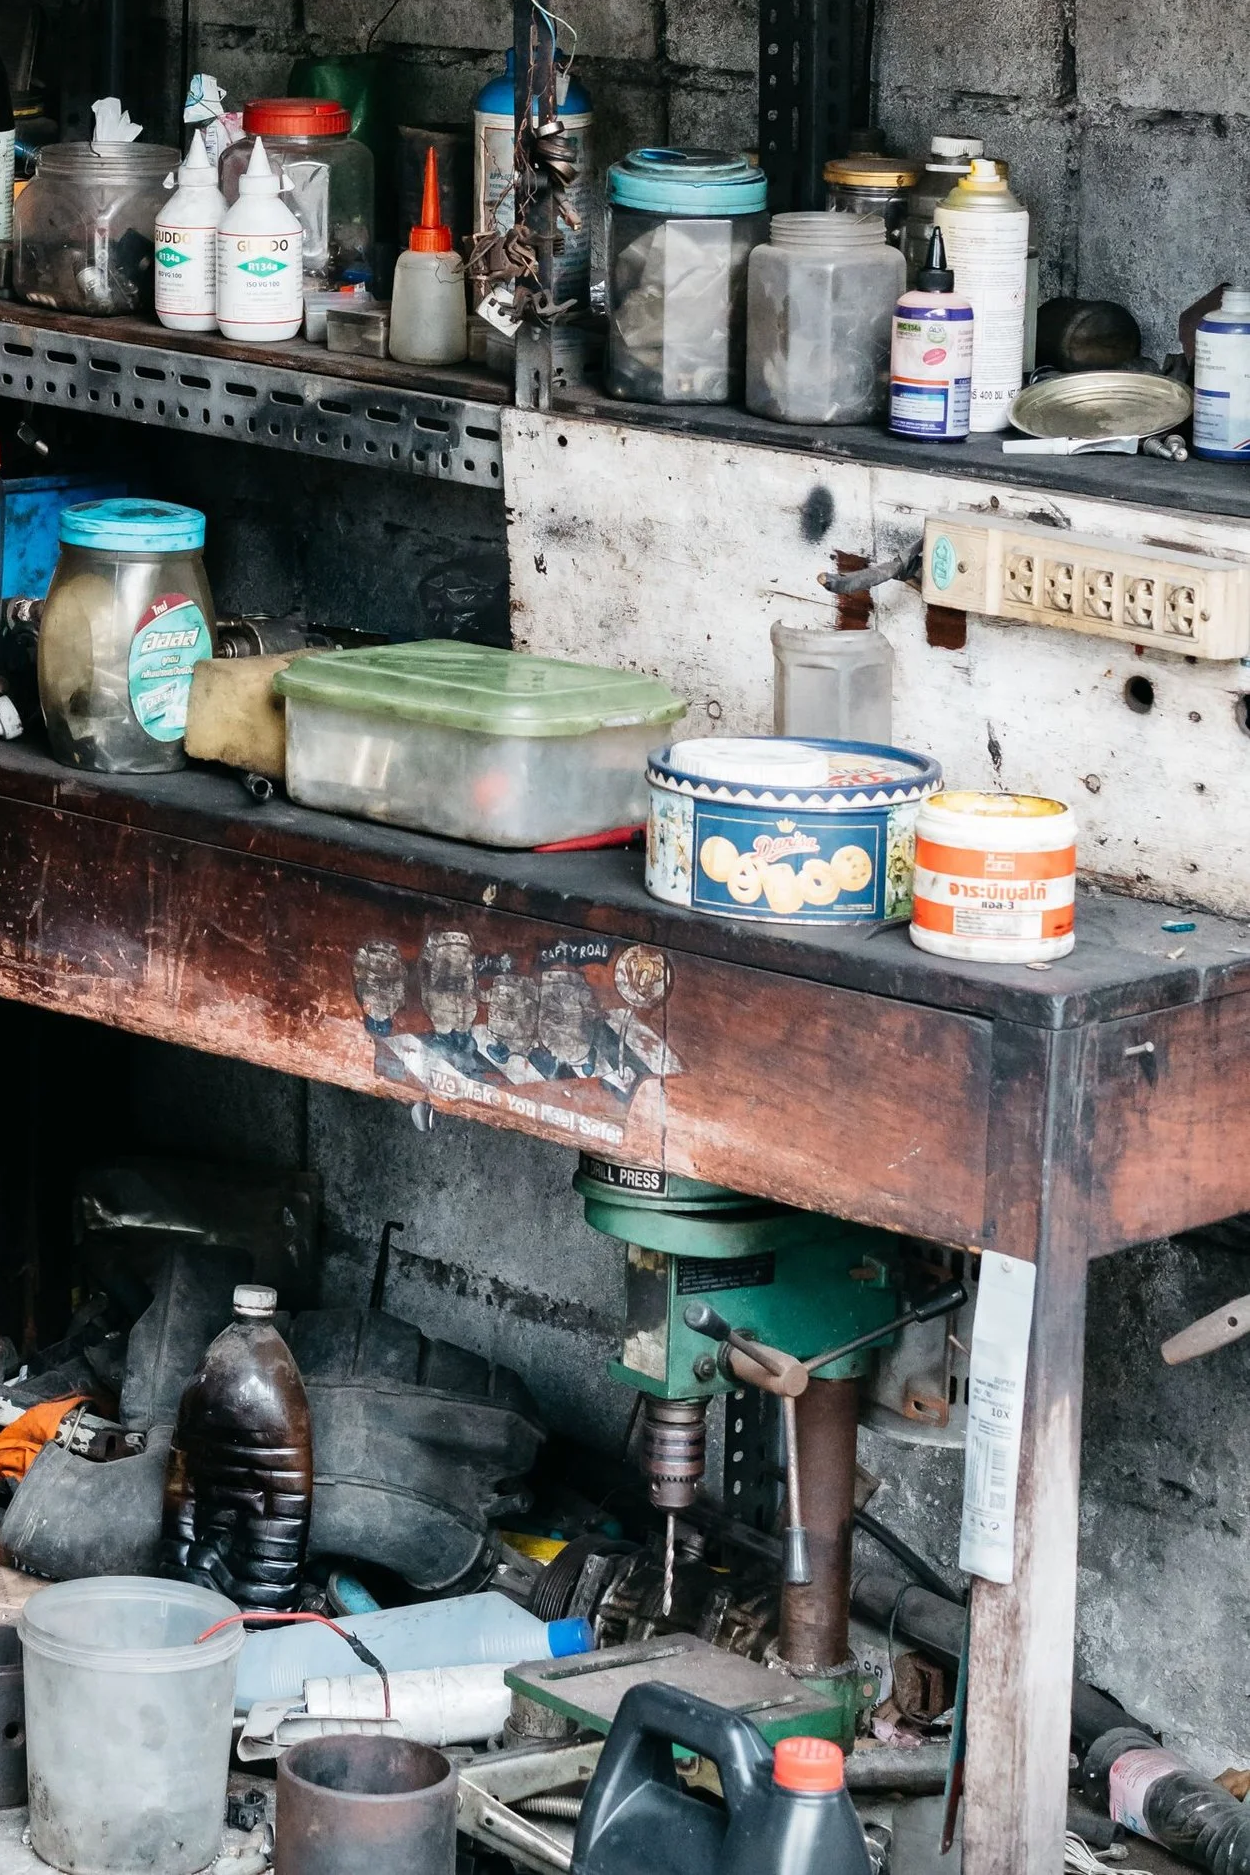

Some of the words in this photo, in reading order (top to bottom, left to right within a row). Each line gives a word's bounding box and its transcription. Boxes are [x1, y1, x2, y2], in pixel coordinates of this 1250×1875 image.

[159, 252, 180, 262] R134a
[248, 262, 277, 271] R134a
[752, 830, 819, 860] Danisa
[540, 942, 577, 963] SAFTY
[578, 939, 608, 959] ROAD
[431, 1072, 456, 1094] We
[459, 1081, 501, 1106] Make
[507, 1097, 536, 1116] You
[620, 1168, 660, 1190] PRESS
